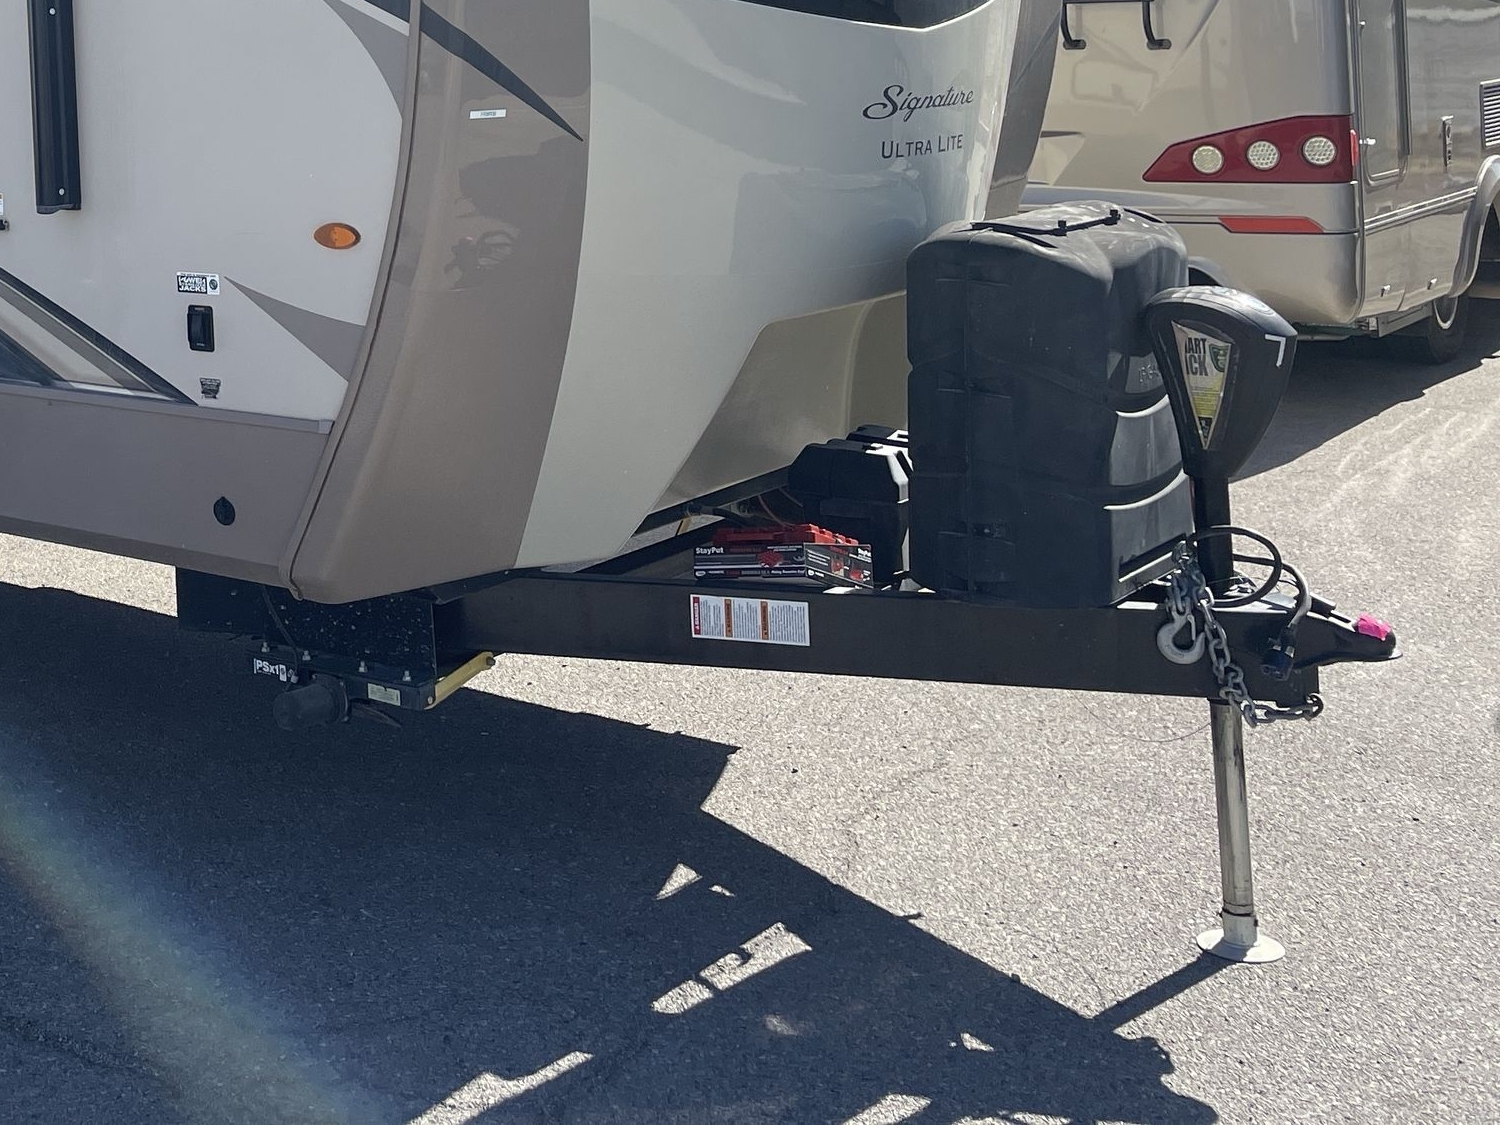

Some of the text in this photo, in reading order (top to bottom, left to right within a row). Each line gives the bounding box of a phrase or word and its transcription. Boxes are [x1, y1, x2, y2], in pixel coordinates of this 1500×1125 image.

[862, 84, 974, 122] Signature
[881, 133, 964, 159] ULTRA LITE
[1185, 337, 1207, 355] ART
[1186, 354, 1209, 377] CK
[695, 546, 724, 555] StayPut
